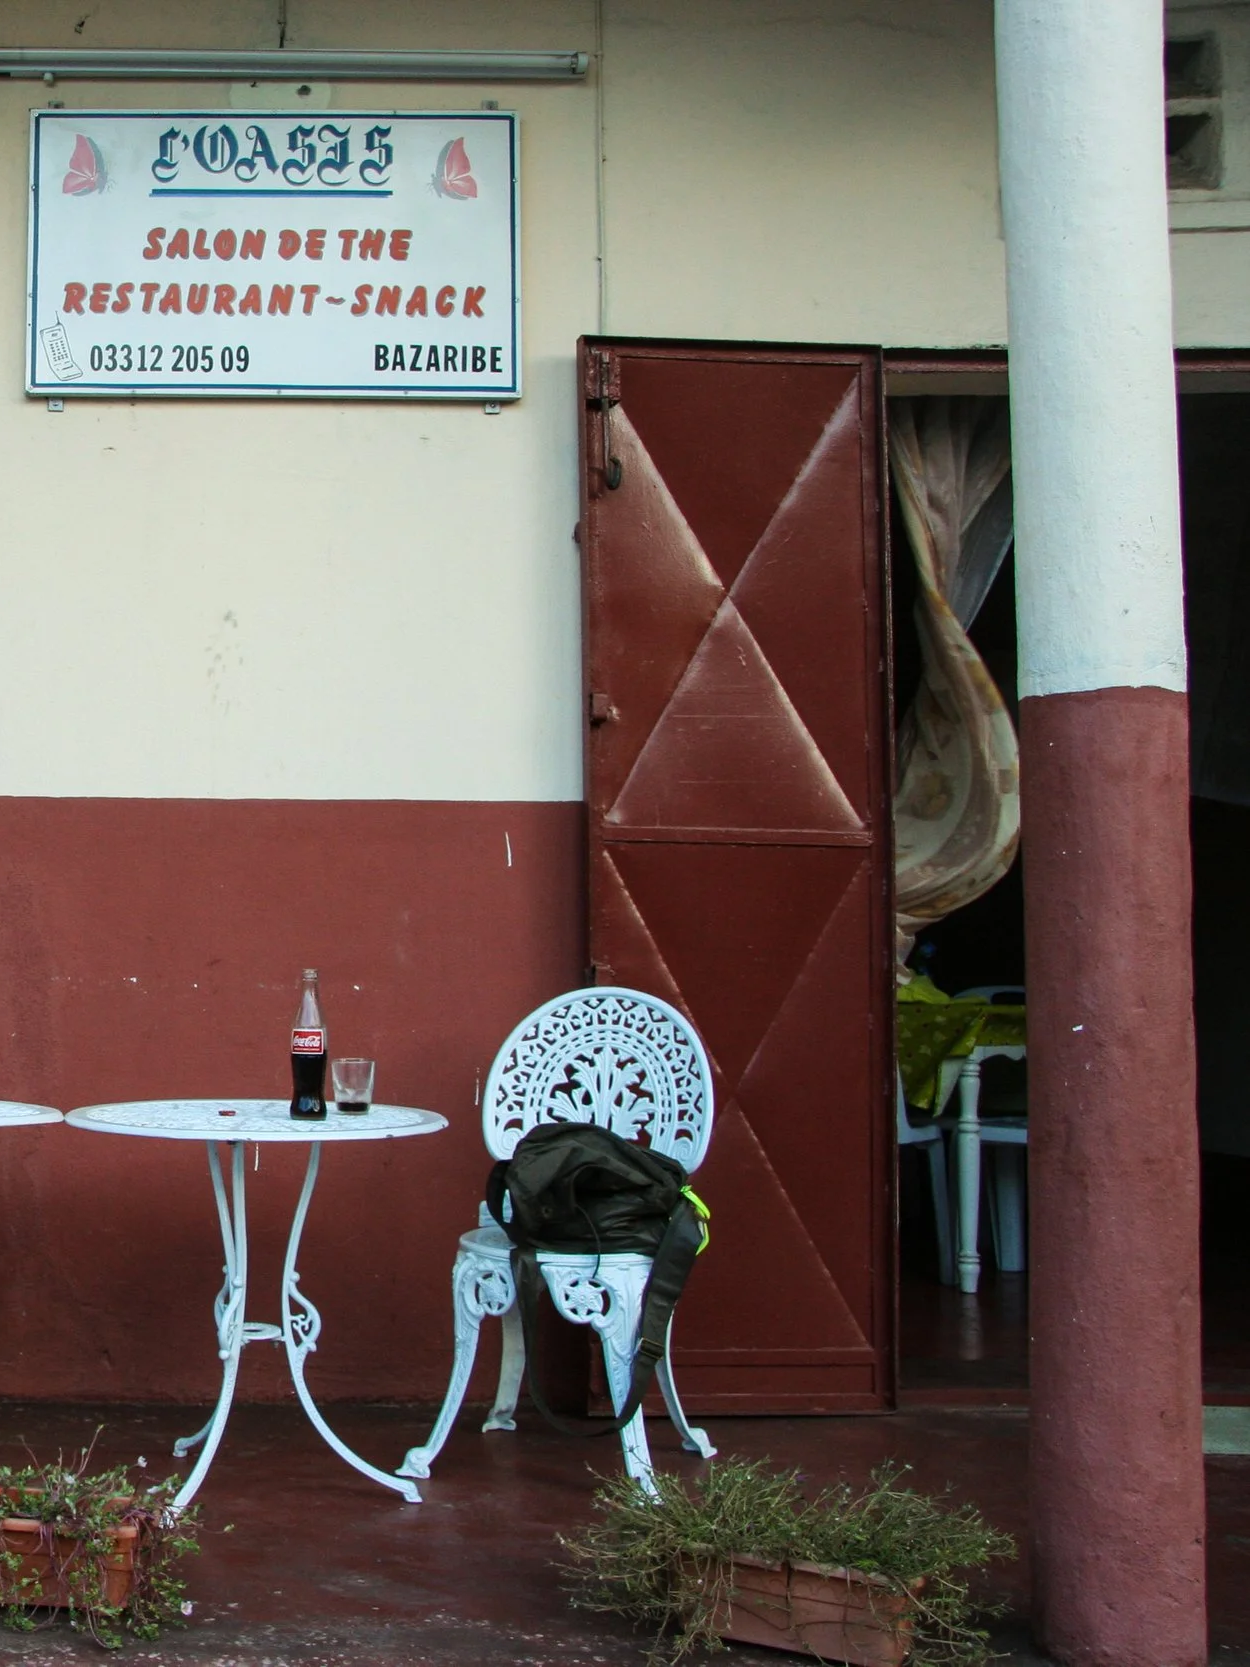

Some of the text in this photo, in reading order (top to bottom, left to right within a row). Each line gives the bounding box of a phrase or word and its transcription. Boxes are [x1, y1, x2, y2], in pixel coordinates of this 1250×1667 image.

[143, 227, 414, 261] SALON DE THE
[374, 344, 503, 373] BAZARIBE
